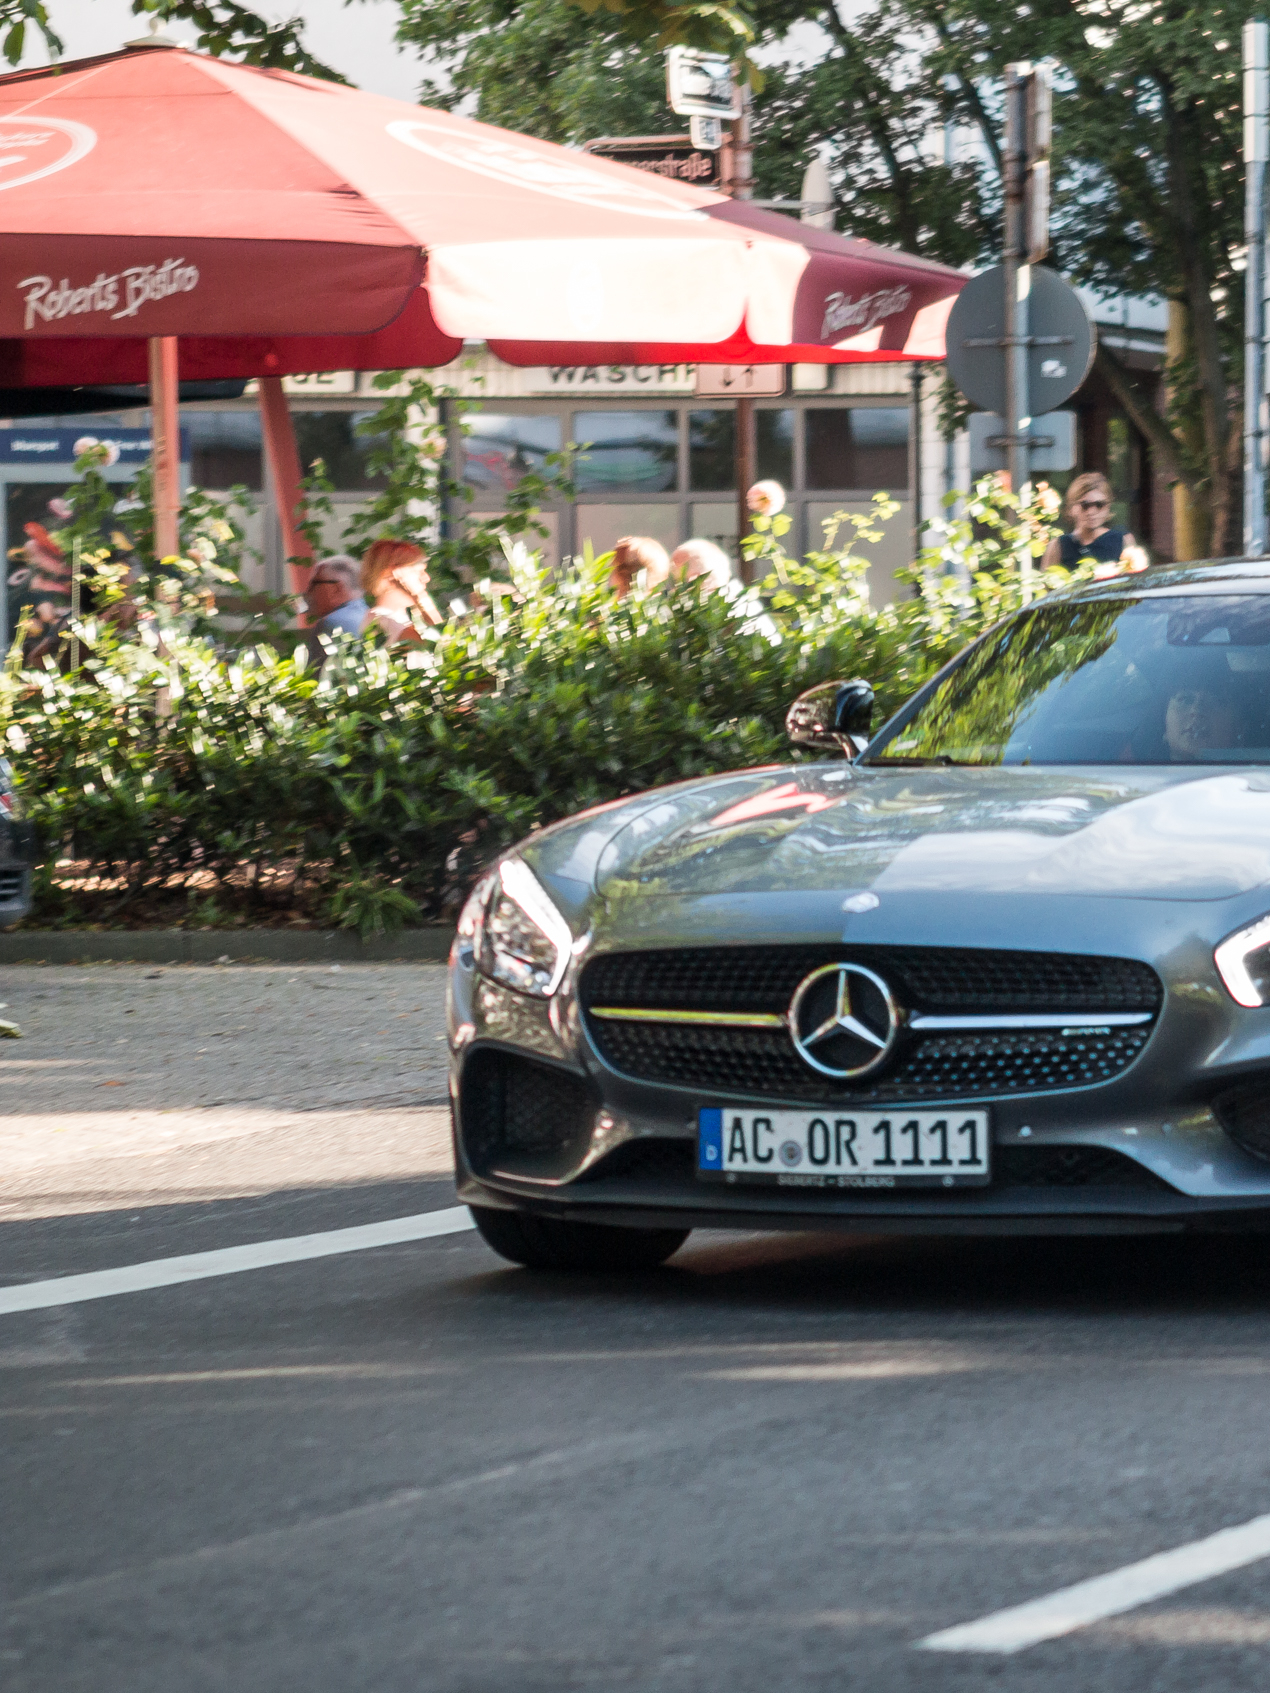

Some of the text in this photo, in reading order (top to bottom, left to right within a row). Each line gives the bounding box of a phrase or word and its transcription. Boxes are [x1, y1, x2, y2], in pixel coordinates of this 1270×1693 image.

[16, 257, 200, 330] Roberts Bistro
[728, 1117, 982, 1166] AC OR 1111
